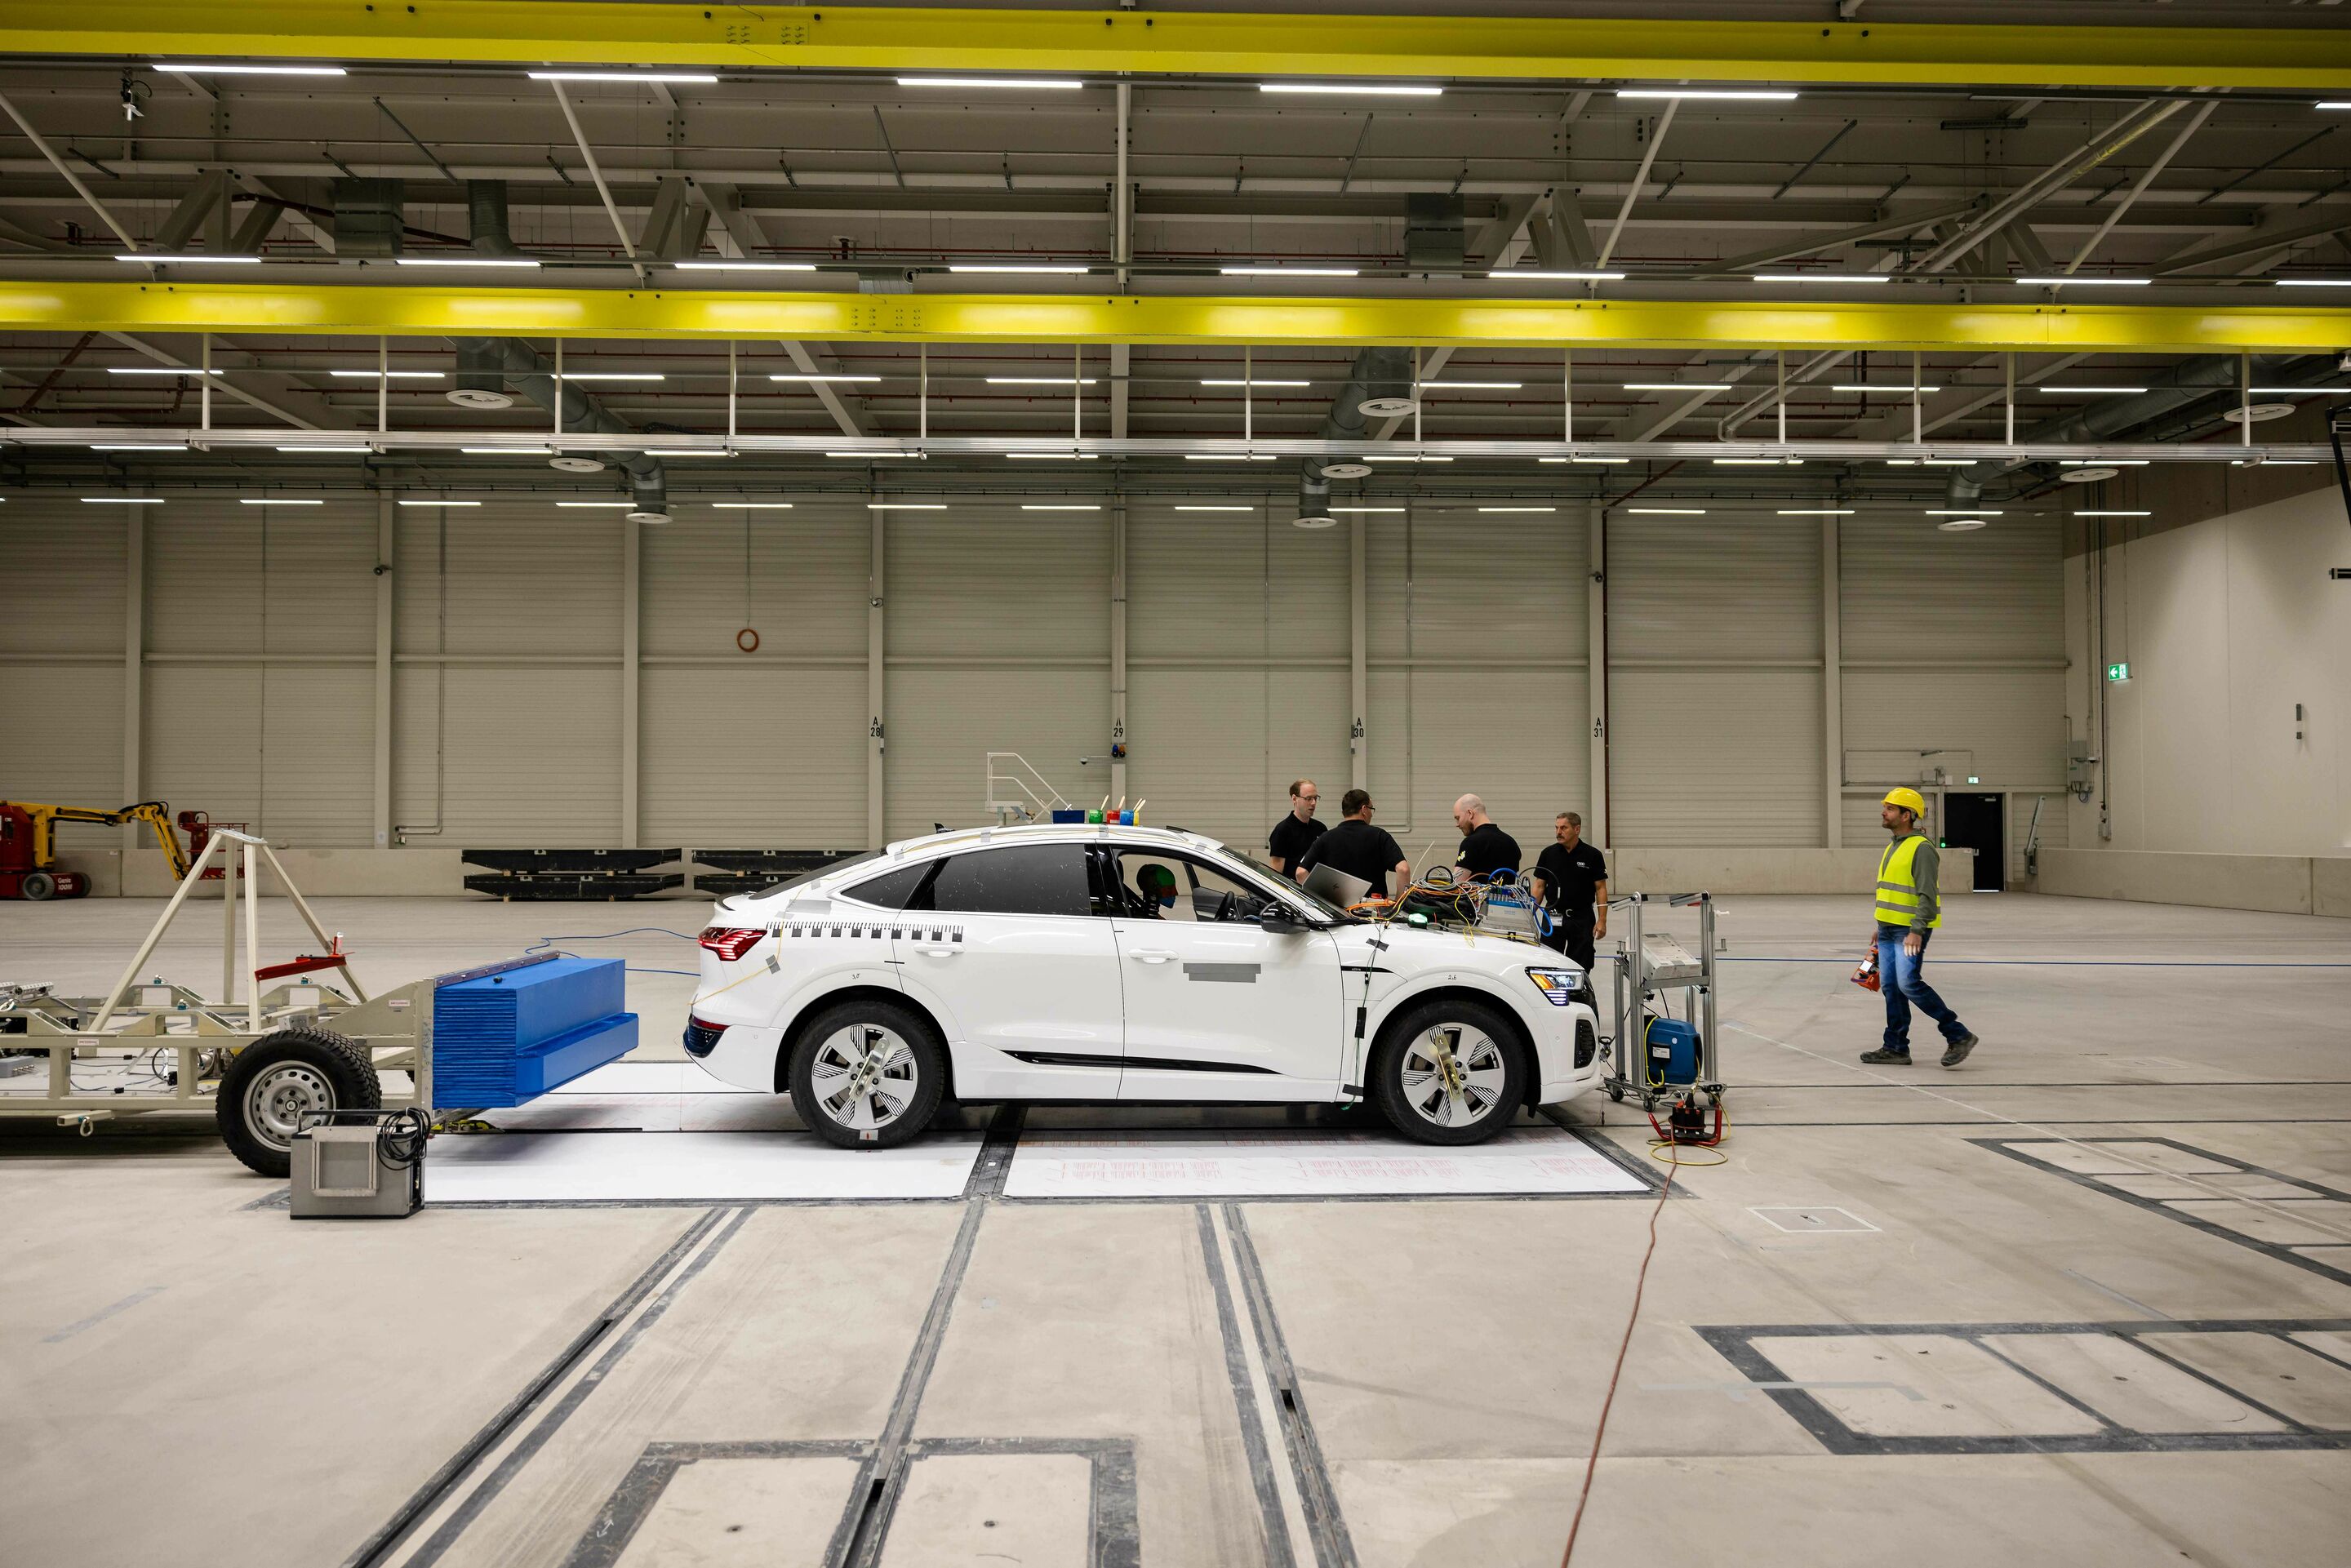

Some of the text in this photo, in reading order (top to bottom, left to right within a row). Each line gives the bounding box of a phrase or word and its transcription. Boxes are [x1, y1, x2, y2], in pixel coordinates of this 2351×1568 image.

[873, 716, 878, 726] A
[1356, 717, 1362, 726] A
[1596, 717, 1602, 726] A
[871, 726, 880, 737] 28
[1114, 727, 1123, 737] 29
[1354, 728, 1364, 738] 30
[1594, 728, 1603, 738] 31
